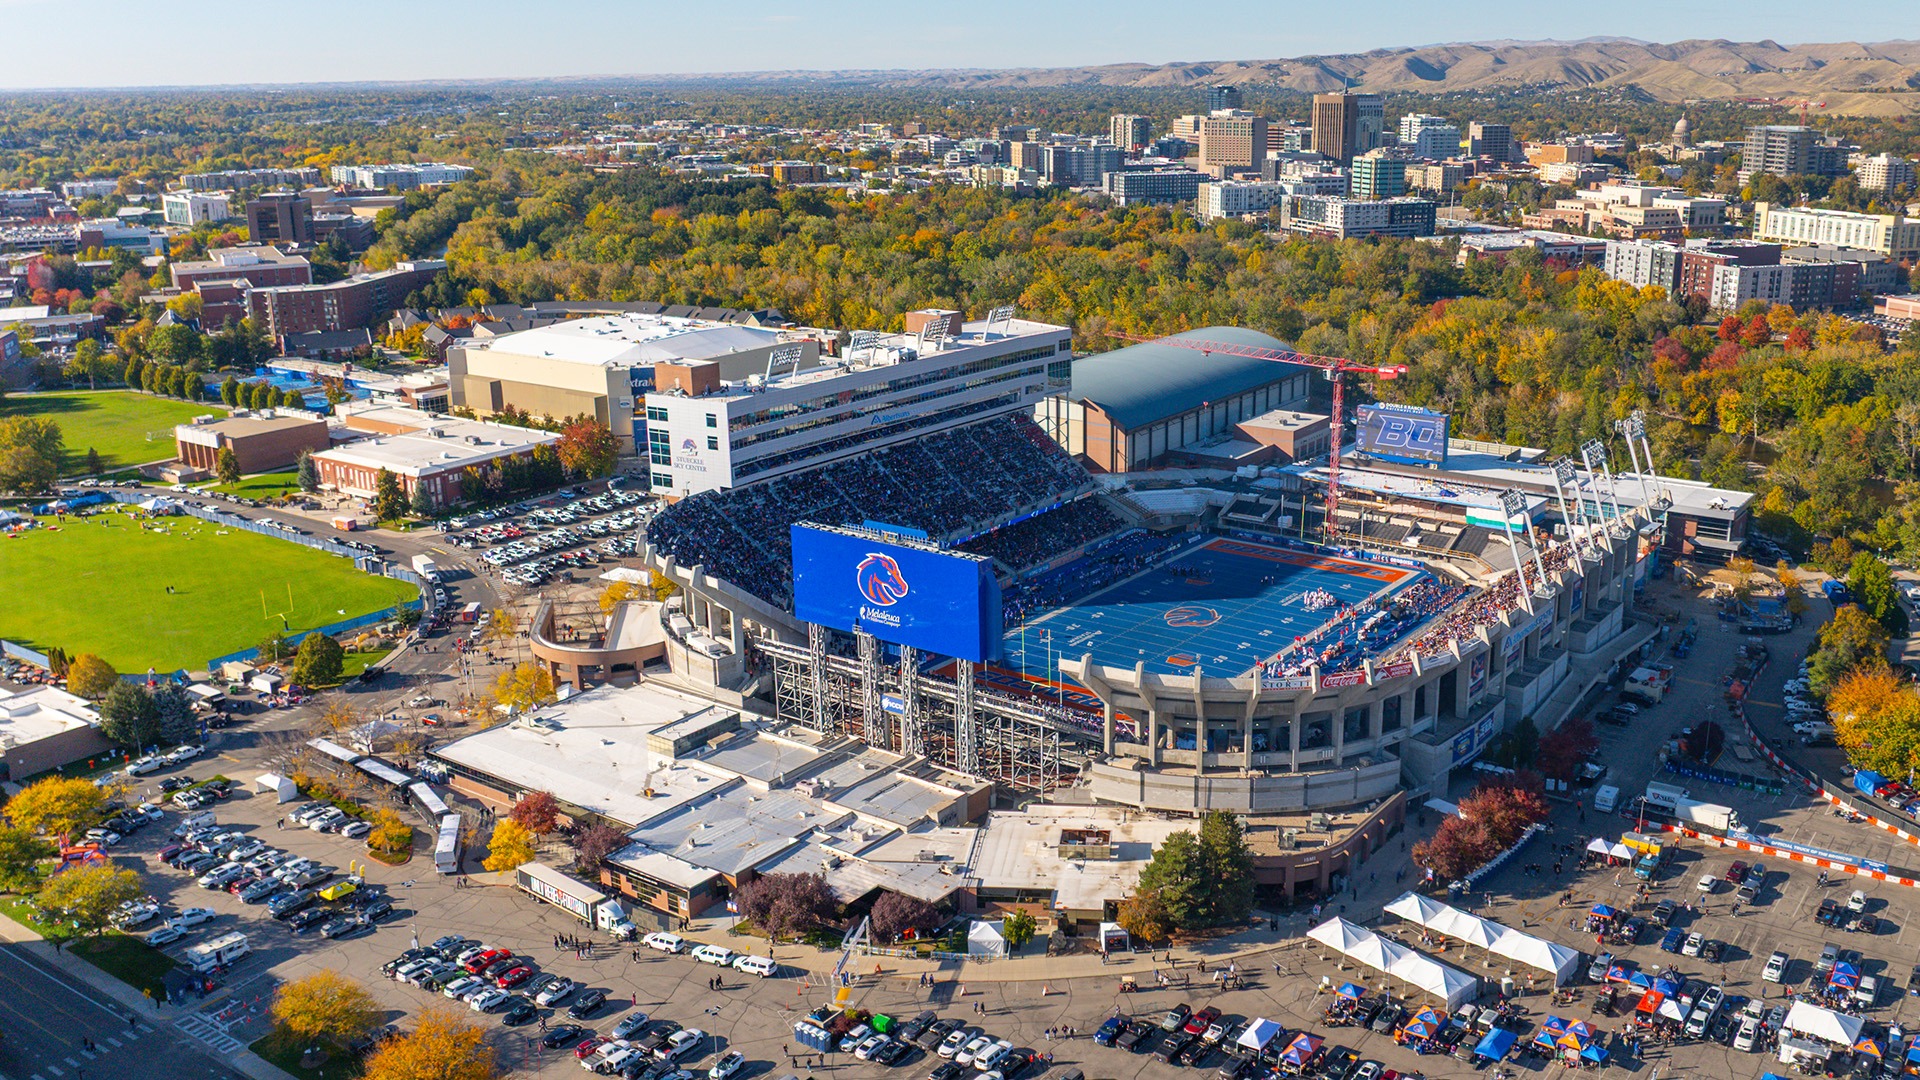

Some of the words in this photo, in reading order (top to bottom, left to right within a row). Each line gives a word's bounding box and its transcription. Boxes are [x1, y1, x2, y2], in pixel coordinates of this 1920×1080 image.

[675, 456, 705, 465] STUECKLE
[685, 464, 708, 473] CENTER
[1732, 832, 1749, 841] Ford
[1771, 840, 1793, 849] OFFICIAL
[1794, 844, 1810, 852] TRUCK
[1828, 852, 1853, 862] BRONCOS
